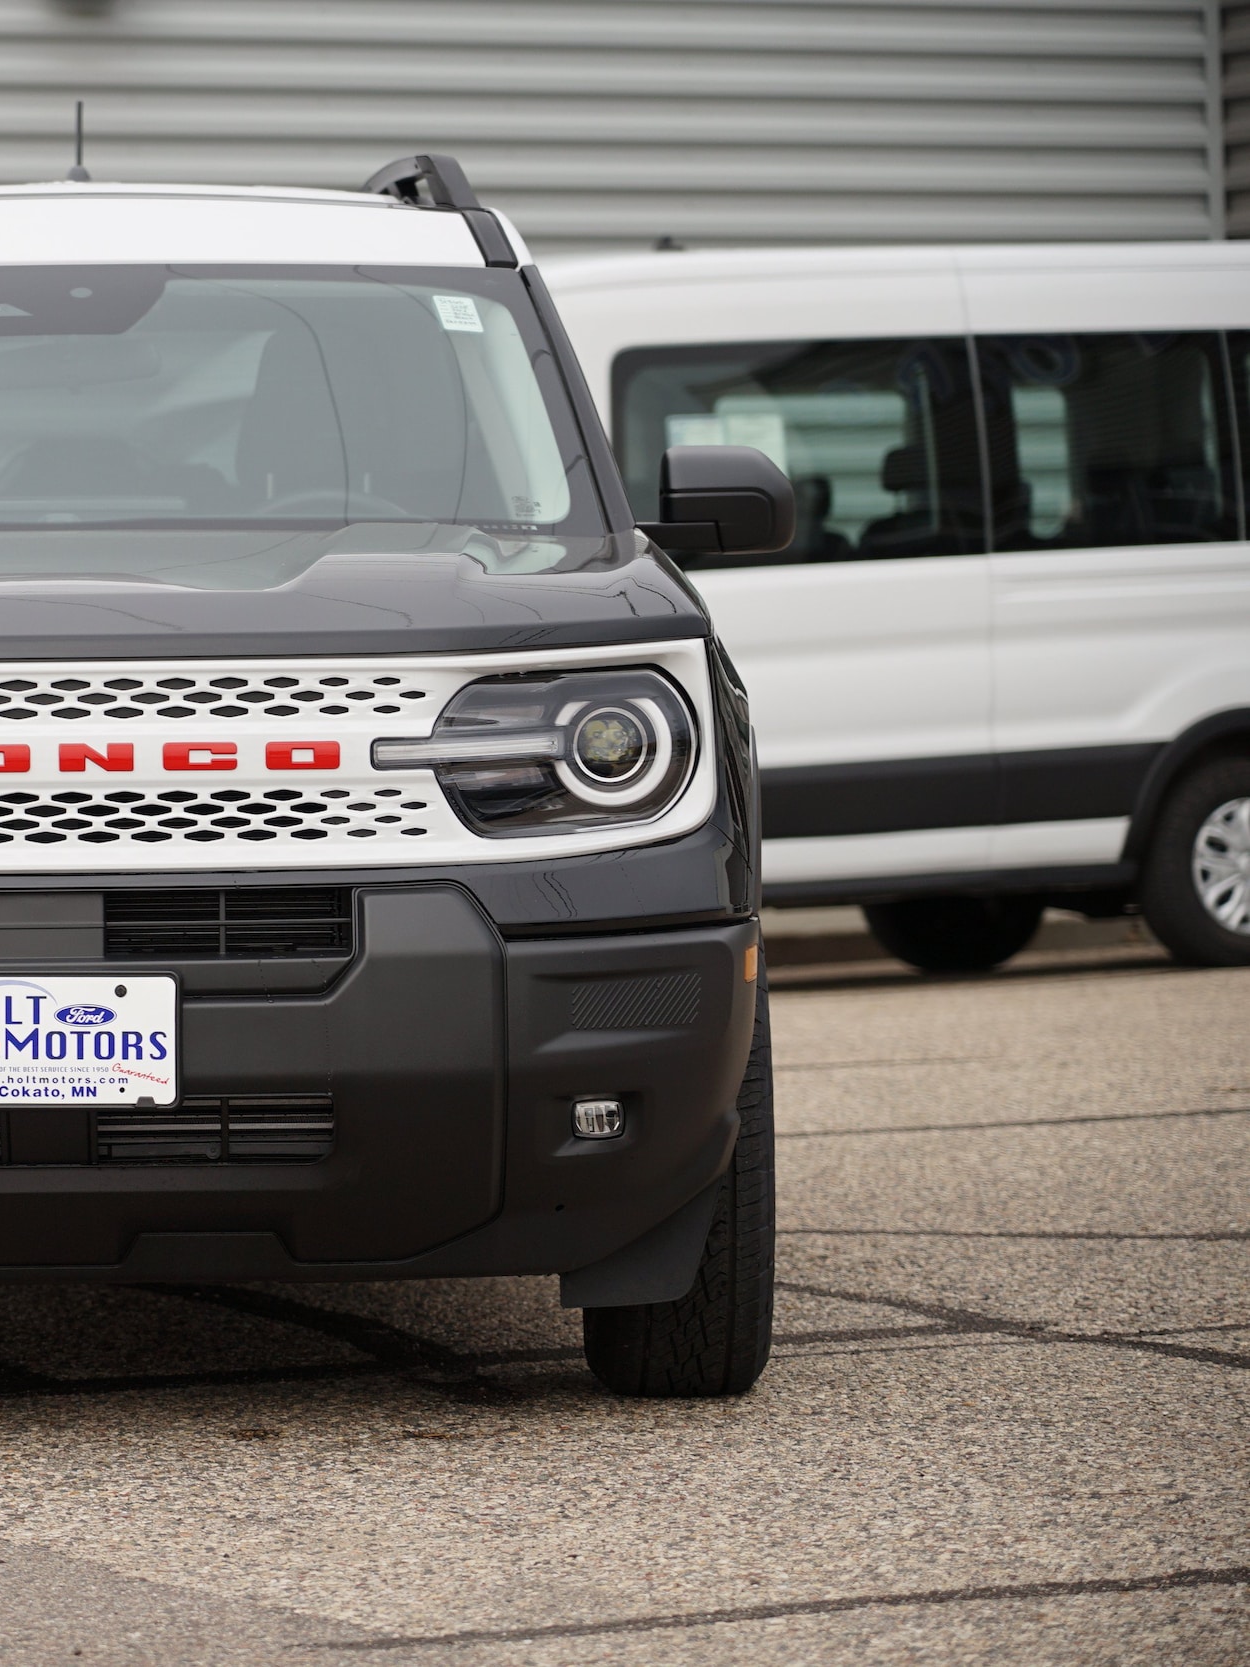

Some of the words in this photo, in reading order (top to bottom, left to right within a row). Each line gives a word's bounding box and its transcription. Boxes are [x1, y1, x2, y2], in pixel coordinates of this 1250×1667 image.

[65, 1007, 105, 1025] Ford
[5, 1028, 168, 1060] MOTORS
[111, 1063, 170, 1085] Guaranteed
[71, 1086, 97, 1097] MN
